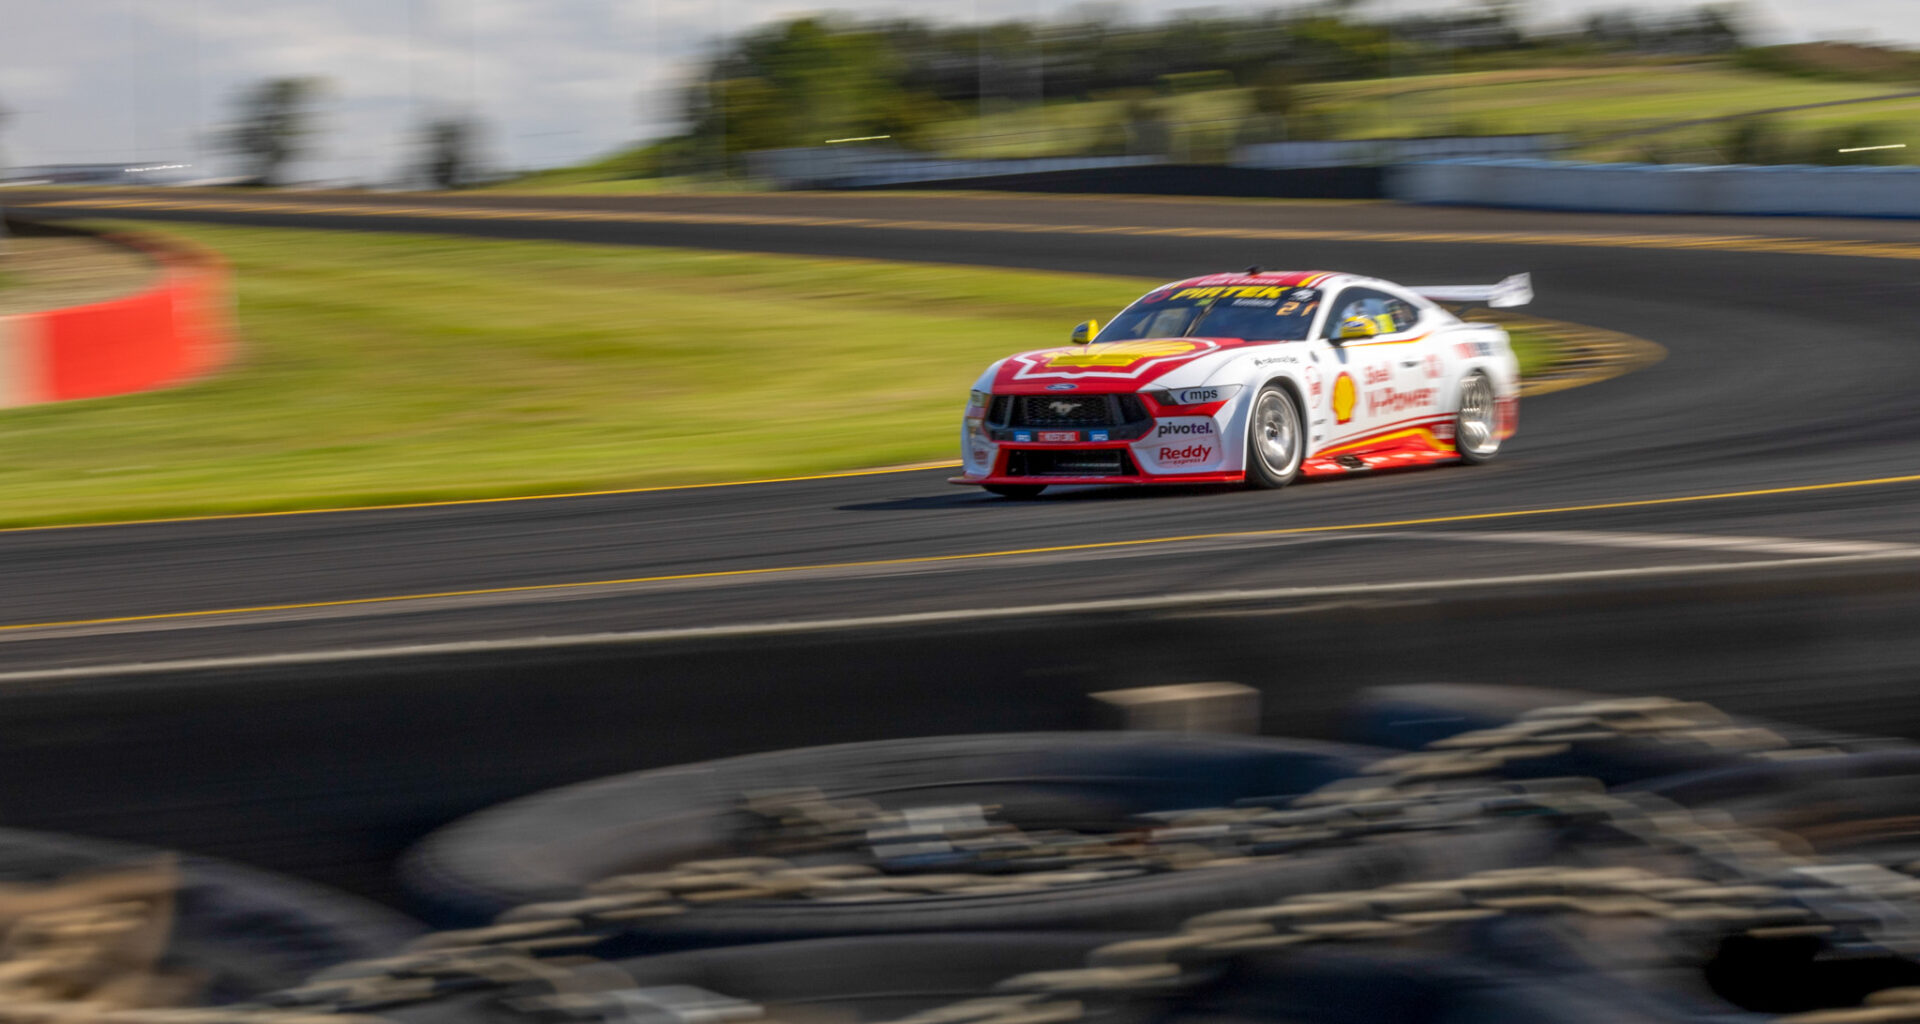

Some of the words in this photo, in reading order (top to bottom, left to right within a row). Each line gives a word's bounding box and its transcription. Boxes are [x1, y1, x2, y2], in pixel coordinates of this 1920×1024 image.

[1190, 389, 1218, 401] mps
[1158, 422, 1213, 437] pivotel.
[1160, 444, 1212, 462] Reddy
